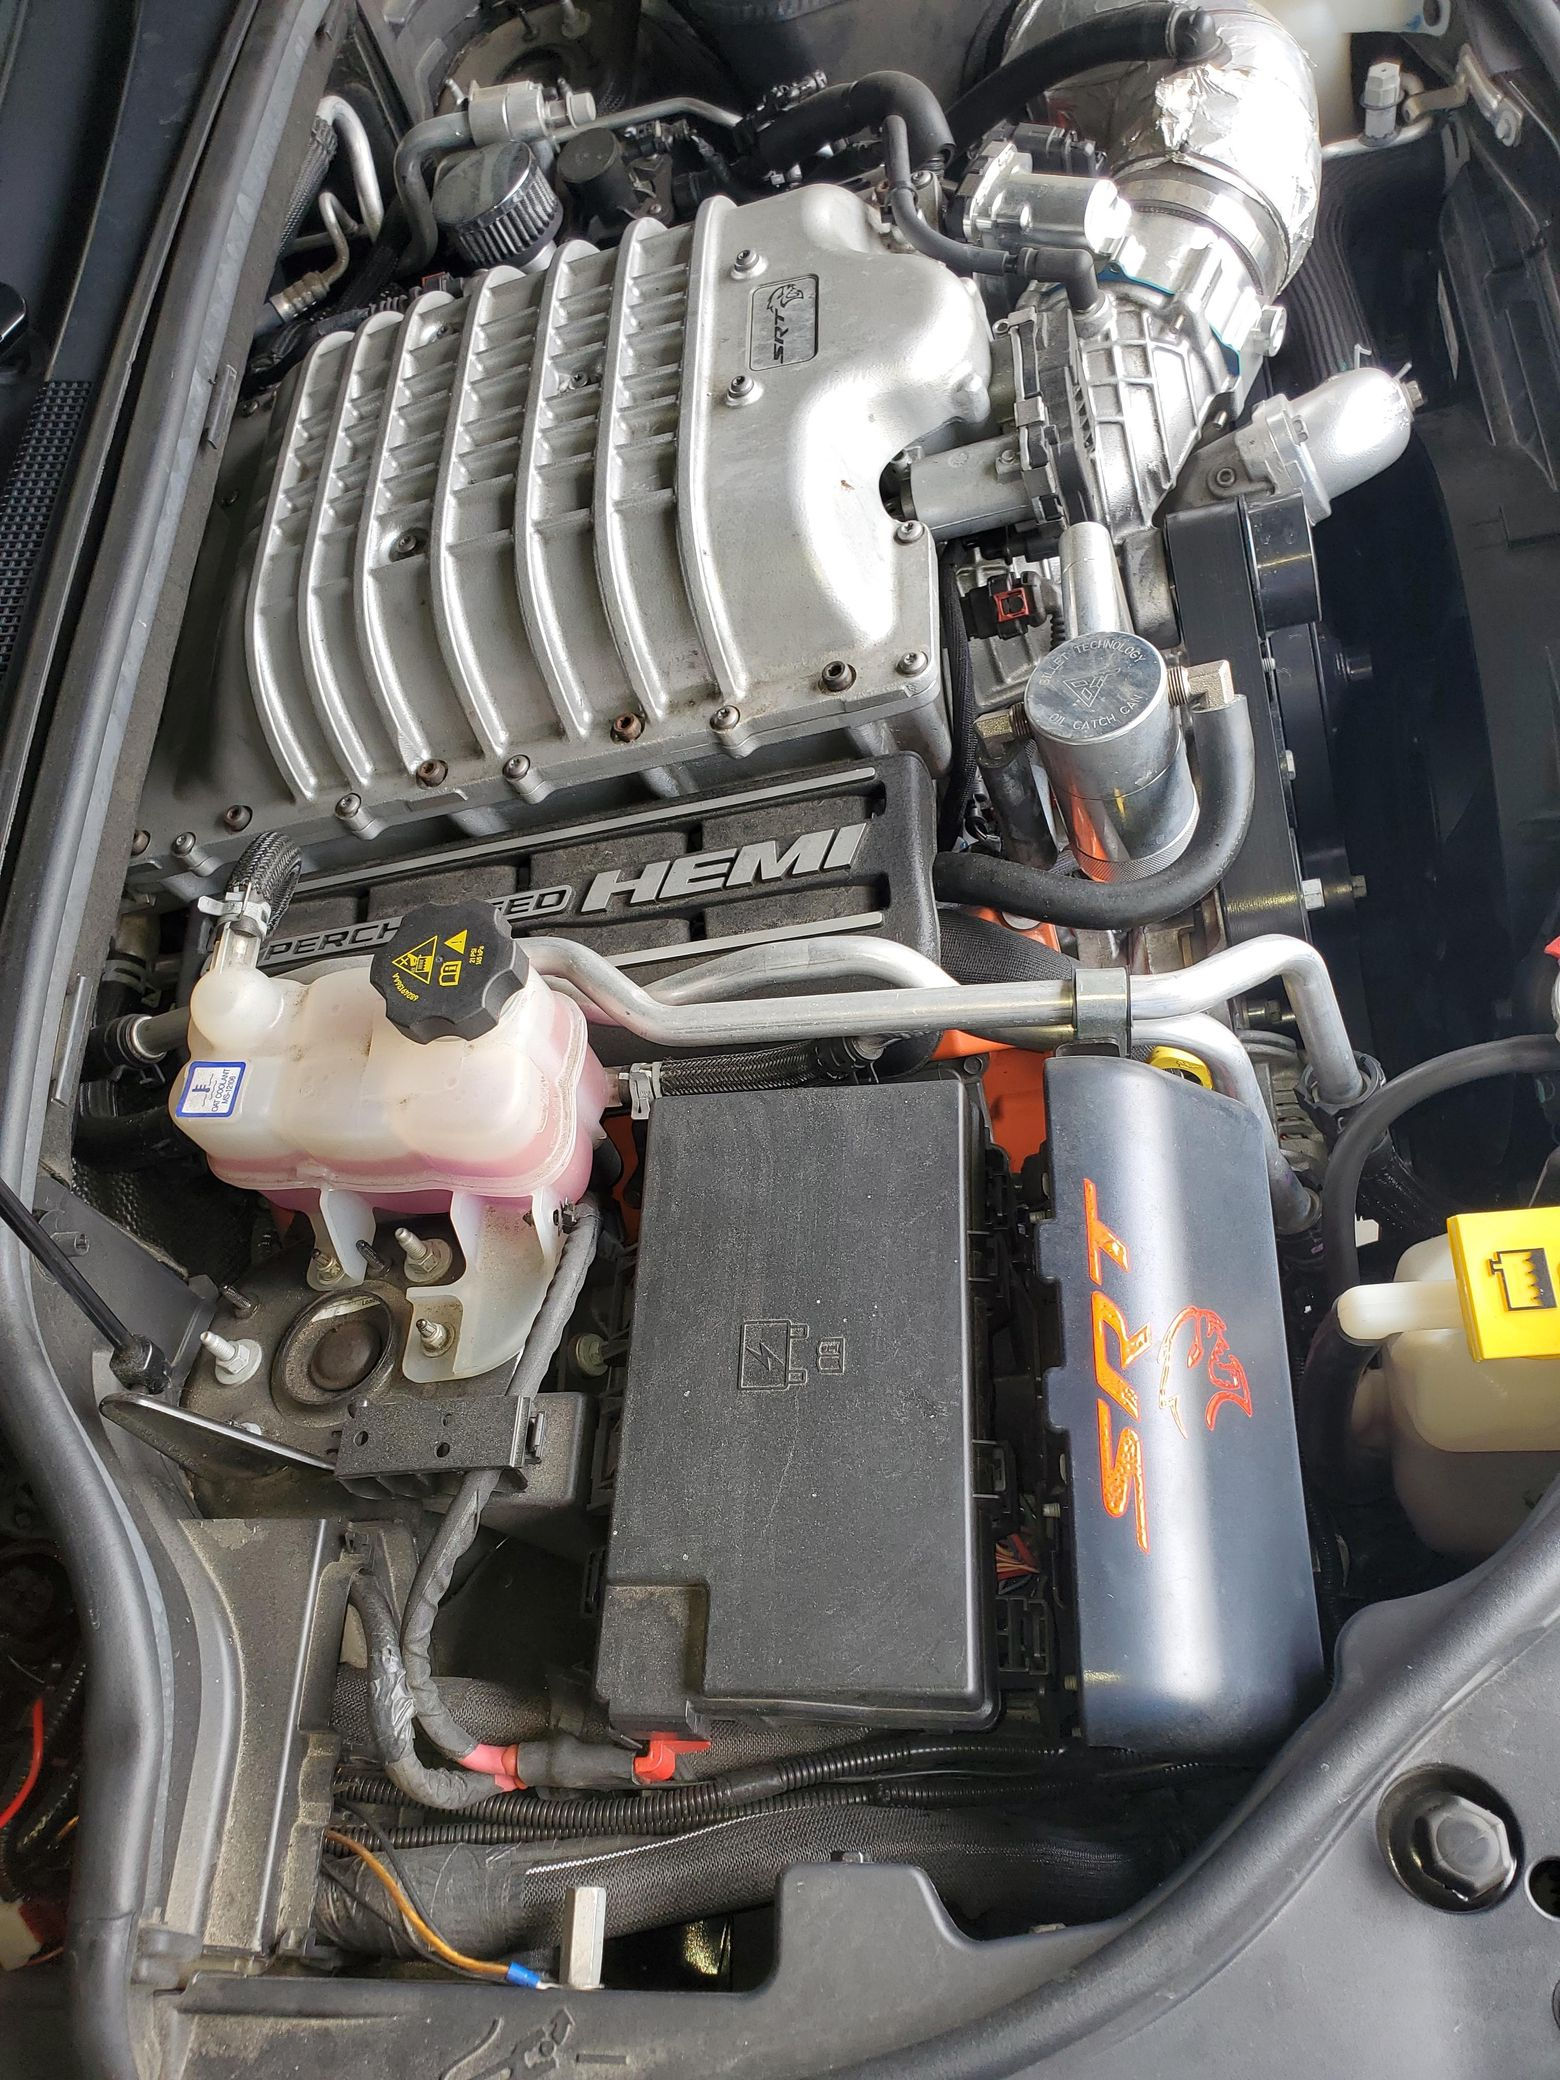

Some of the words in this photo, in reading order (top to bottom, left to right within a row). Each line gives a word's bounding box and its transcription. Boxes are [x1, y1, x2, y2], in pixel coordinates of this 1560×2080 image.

[774, 308, 788, 364] SRT
[1039, 652, 1070, 686] BILLET
[1074, 639, 1146, 663] TECHNOLOGY
[1050, 713, 1067, 727] OIL
[1073, 713, 1116, 730] CATCH
[1119, 694, 1142, 715] CAN
[581, 823, 866, 912] HEMI
[211, 1100, 220, 1112] OAT
[215, 1068, 230, 1099] COOLANT
[1084, 1178, 1152, 1554] SRT
